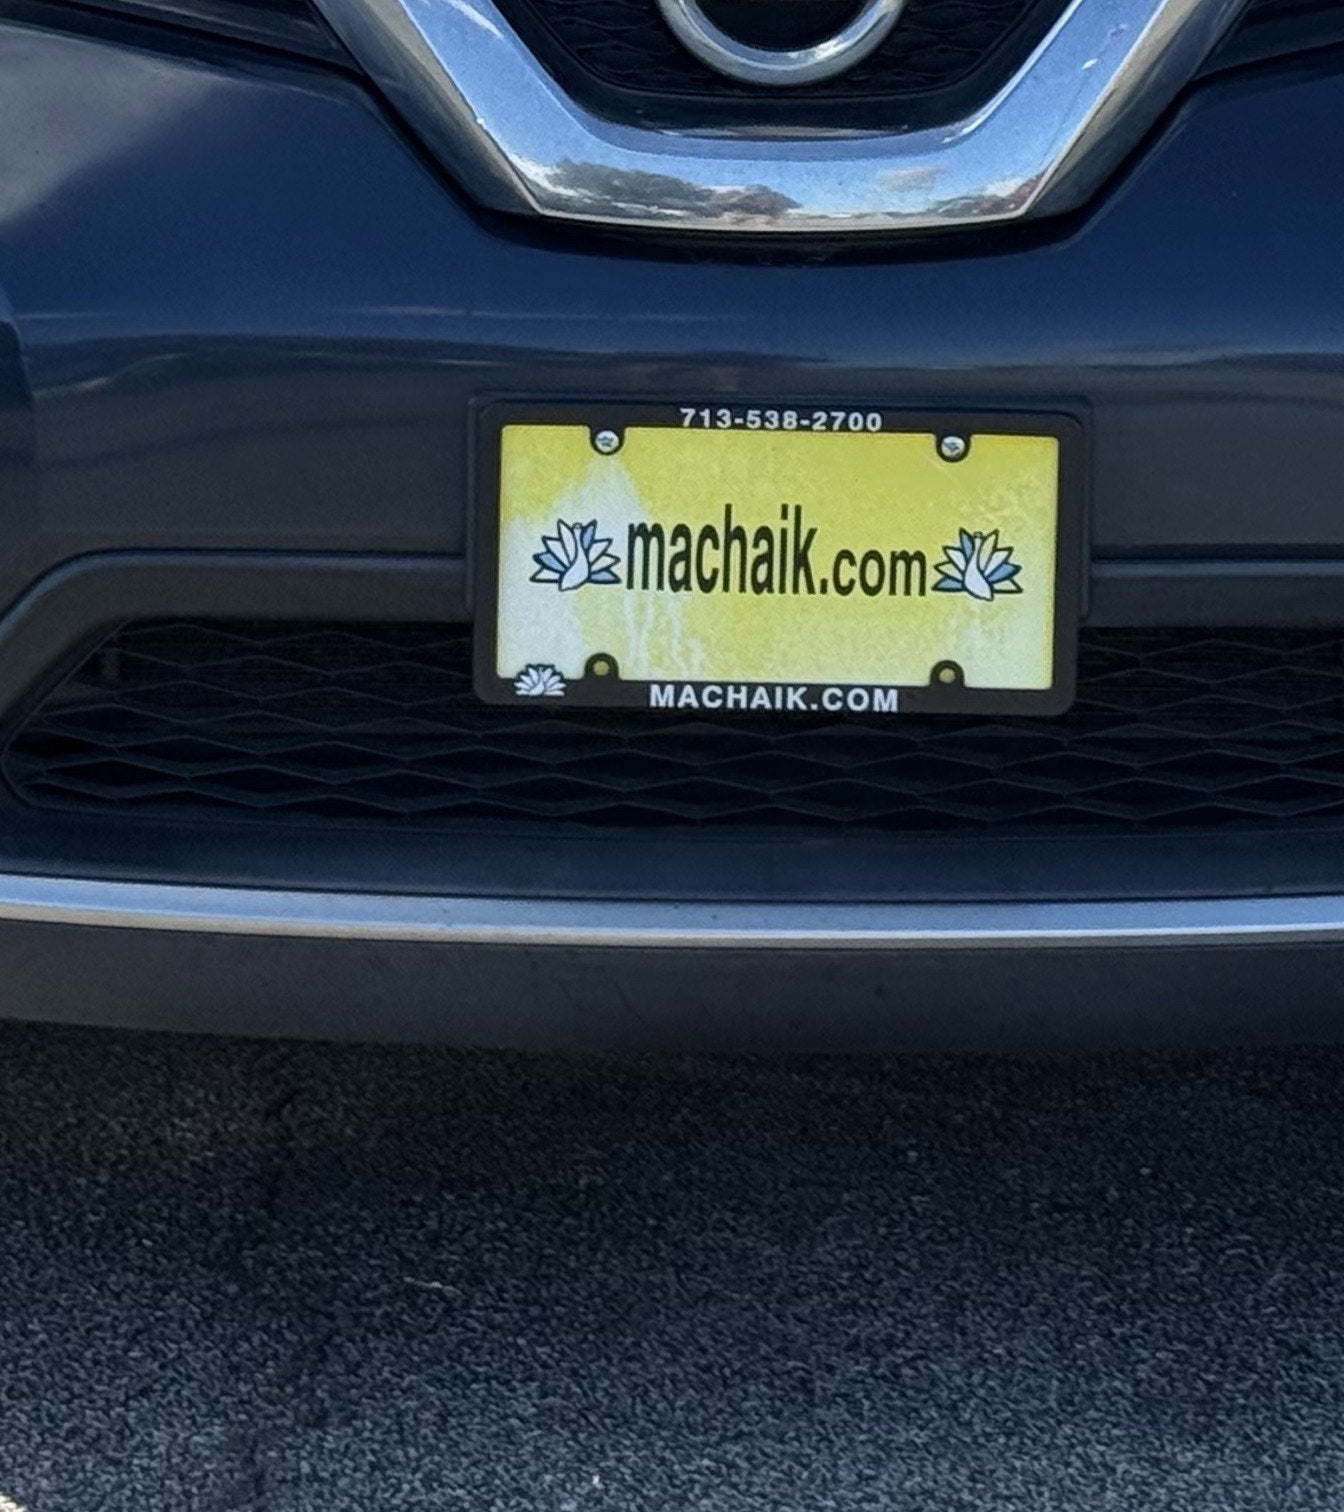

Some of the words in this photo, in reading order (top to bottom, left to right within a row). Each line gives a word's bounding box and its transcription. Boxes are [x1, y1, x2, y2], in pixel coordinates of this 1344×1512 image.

[680, 407, 883, 432] 713-538-2700
[625, 503, 927, 596] machaik.com
[650, 684, 899, 712] MACHAIK.COM
